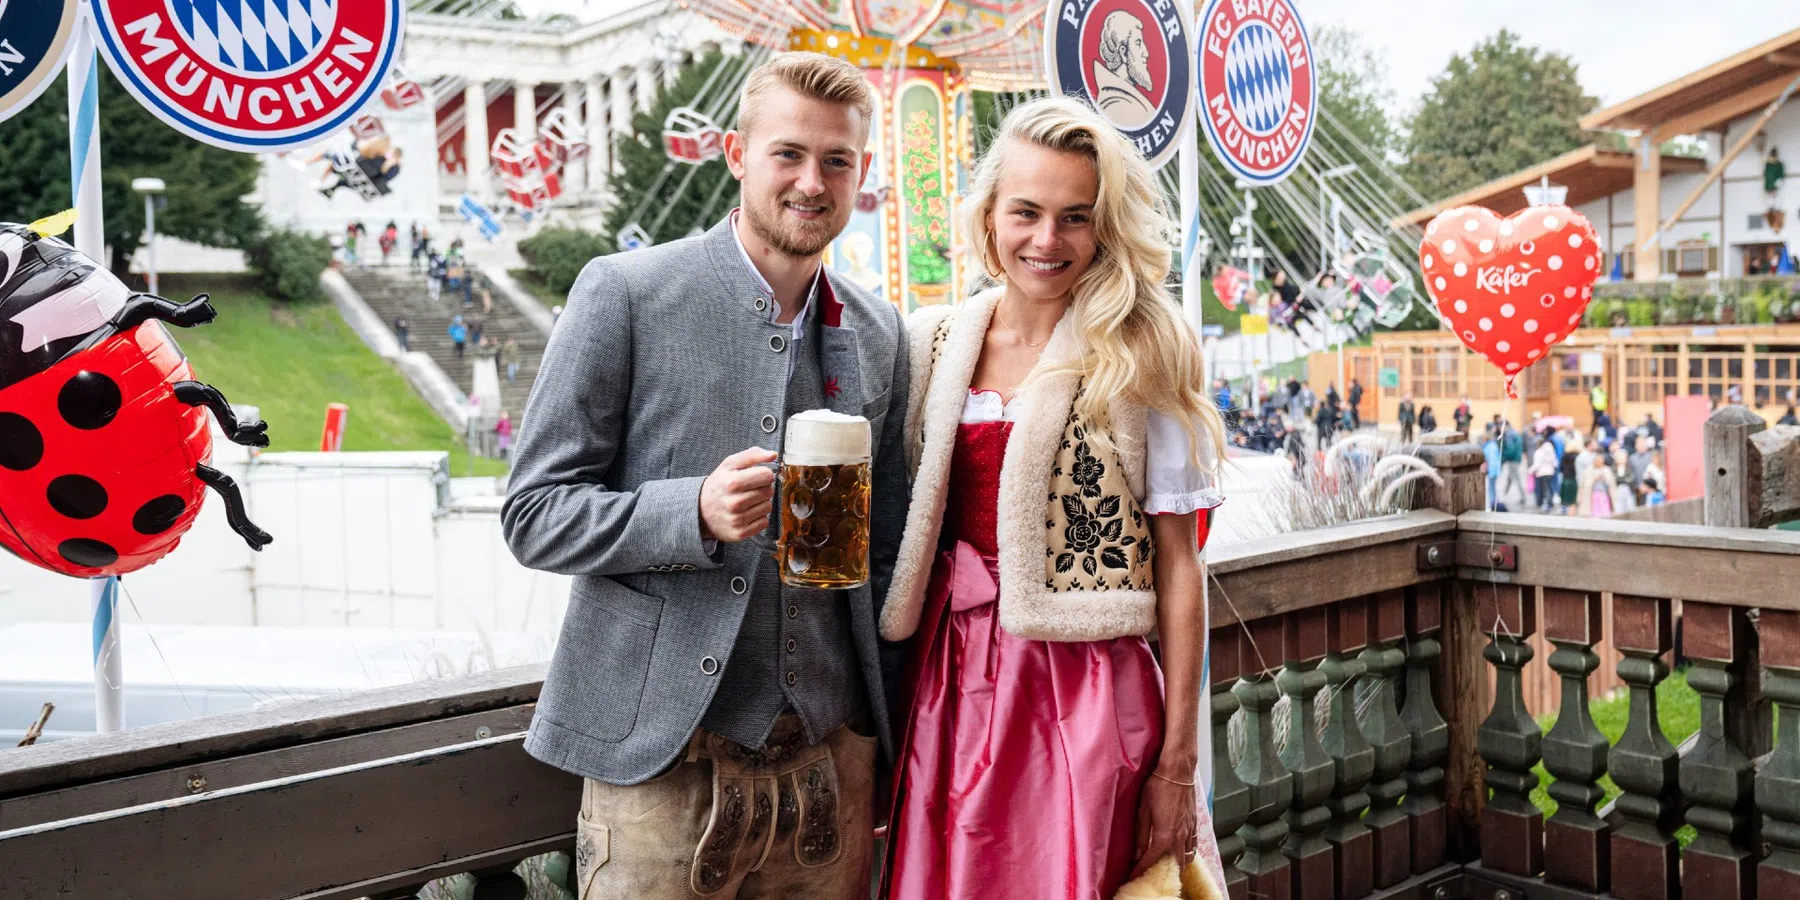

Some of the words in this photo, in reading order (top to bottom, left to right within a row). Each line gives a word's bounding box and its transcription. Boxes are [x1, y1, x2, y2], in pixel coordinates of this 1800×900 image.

[124, 13, 374, 124] MÜNCHEN
[1208, 12, 1232, 59] FC
[1231, 0, 1306, 69] BAYERN
[1210, 92, 1306, 167] MÜNCHEN
[1476, 264, 1542, 295] Käfer
